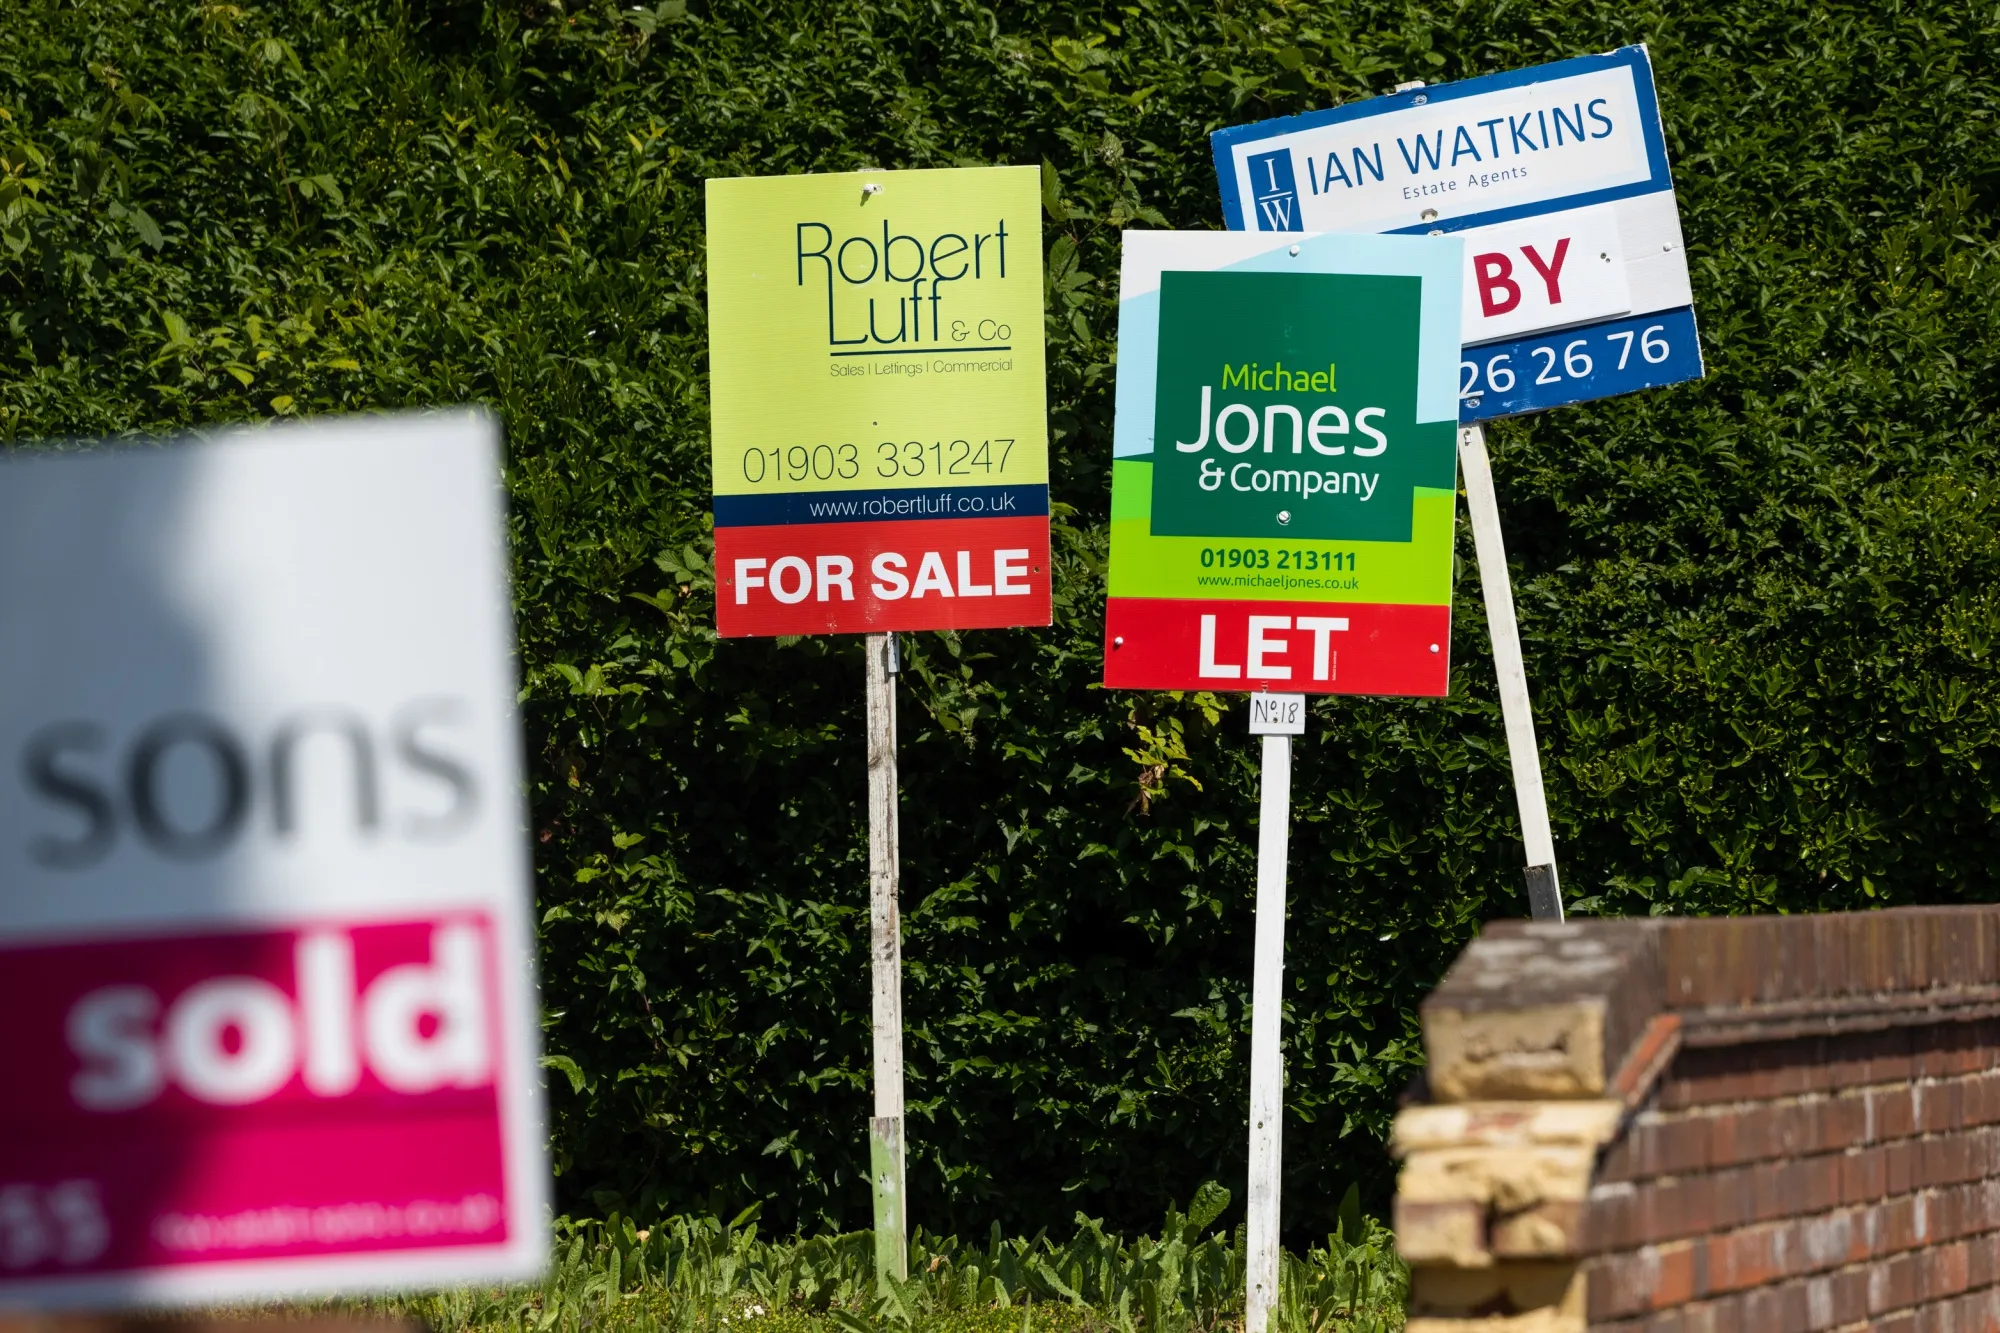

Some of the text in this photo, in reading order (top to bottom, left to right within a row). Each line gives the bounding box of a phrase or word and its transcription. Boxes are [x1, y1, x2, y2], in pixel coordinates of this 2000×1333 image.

[1306, 98, 1614, 195] IAN WATKINS
[1263, 157, 1280, 192] I
[1402, 166, 1528, 200] Estate Agents
[1260, 197, 1293, 231] W
[797, 218, 1009, 286] Robert
[1472, 237, 1571, 318] BY
[829, 277, 1012, 345] Luff & Co
[830, 363, 865, 377] Sales
[874, 362, 923, 377] Lettings
[933, 358, 1013, 373] Commercial
[1221, 362, 1337, 393] Michael
[1531, 339, 1594, 385] 26
[1606, 325, 1670, 371] 76
[1176, 385, 1388, 457] Jones
[743, 439, 1016, 483] 01903 331247
[1198, 458, 1380, 502] & Company
[809, 492, 1016, 517] www.robertluff.co.uk
[734, 548, 1031, 605] FOR SALE
[1197, 574, 1359, 590] www.michaeljones.co.uk
[1200, 548, 1356, 572] 01903 213111
[1199, 614, 1349, 680] LET
[18, 694, 484, 874] sons
[66, 918, 490, 1112] sold
